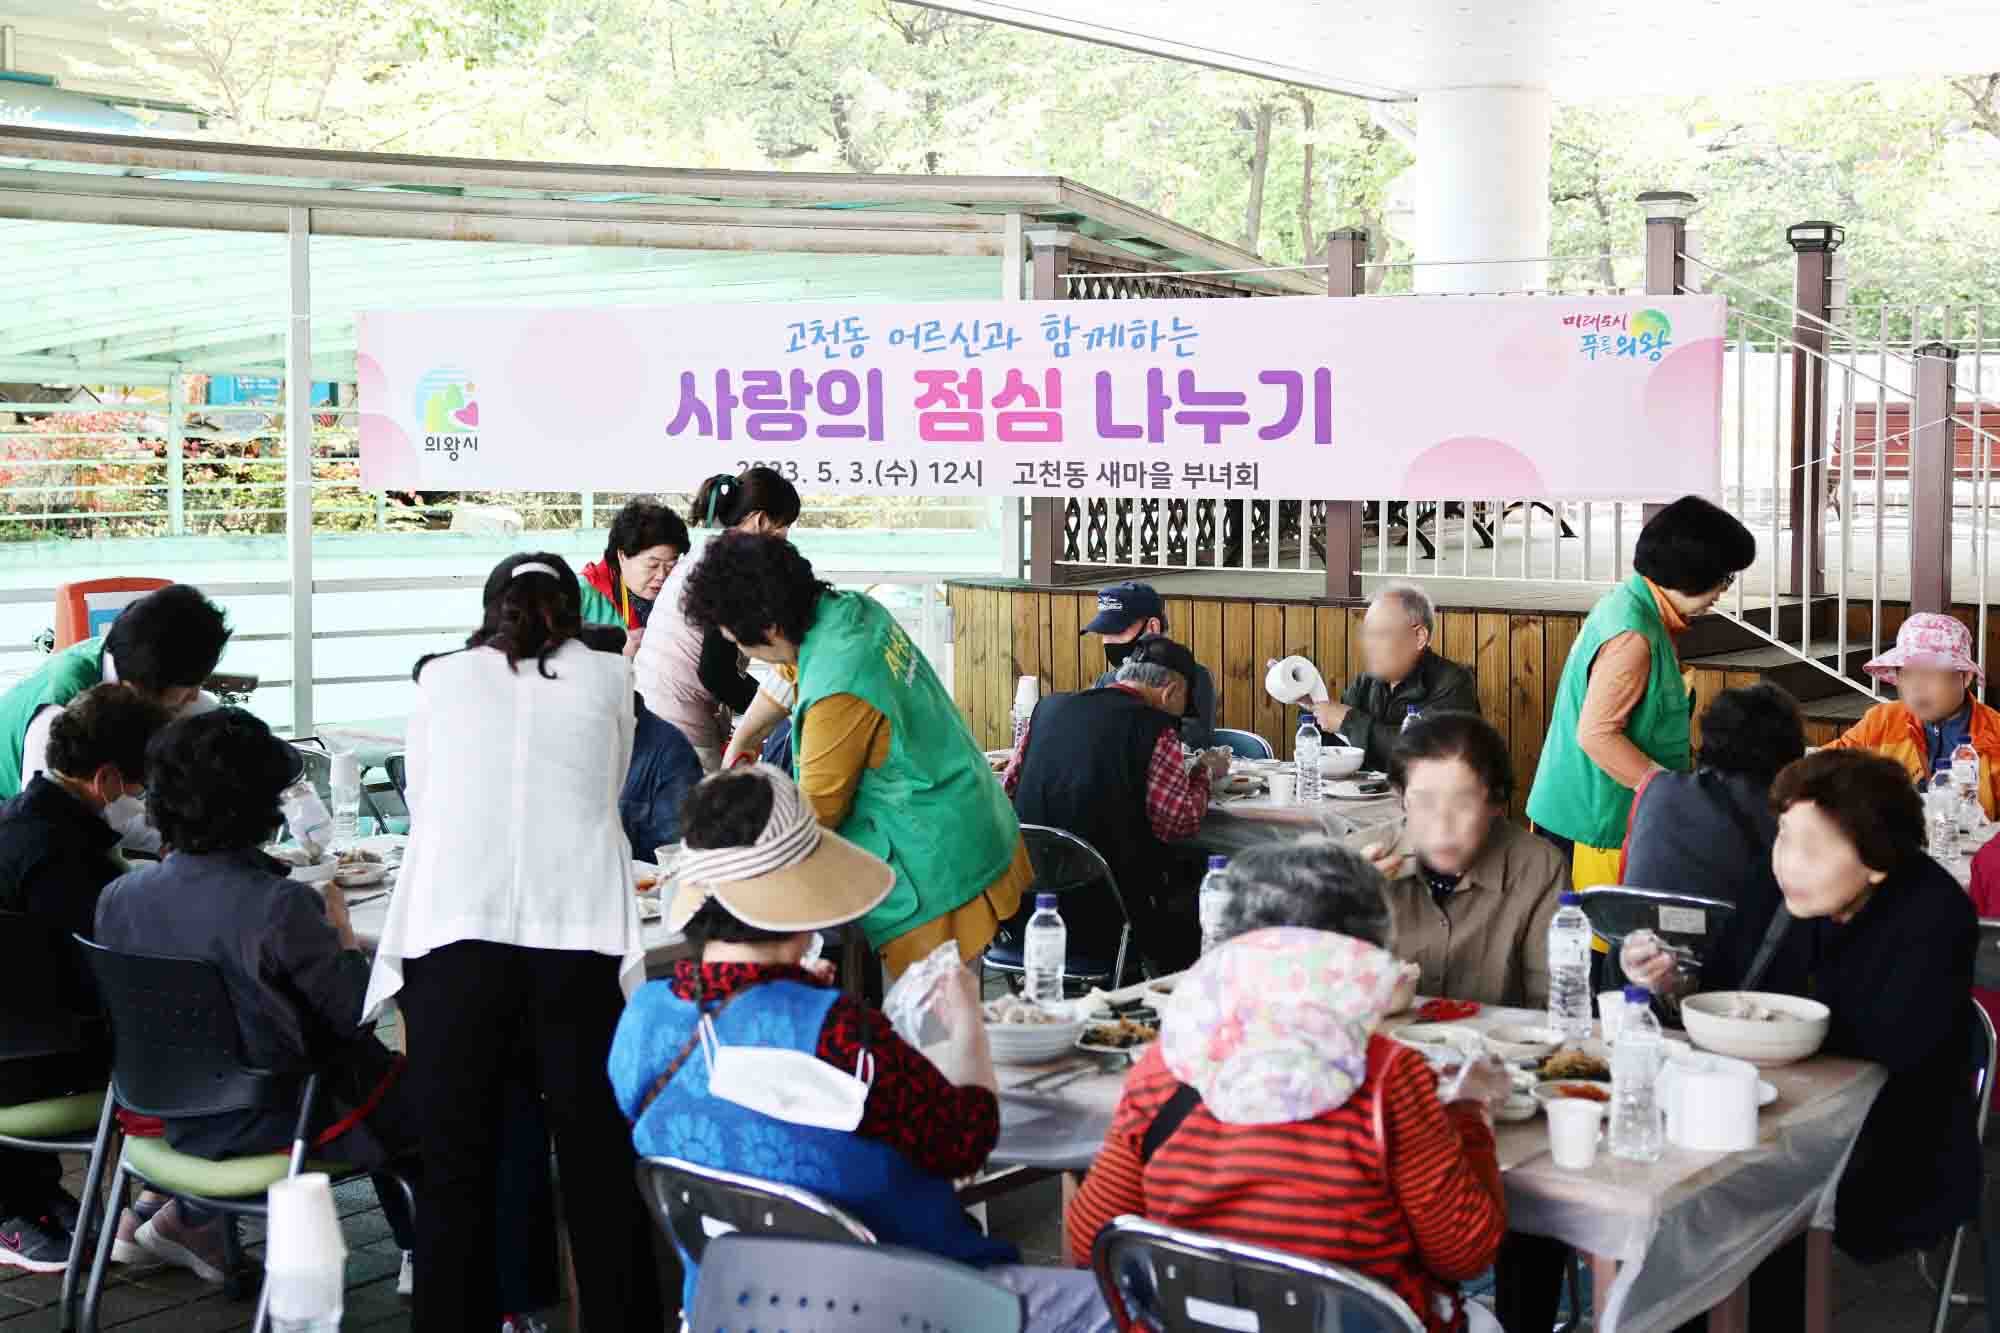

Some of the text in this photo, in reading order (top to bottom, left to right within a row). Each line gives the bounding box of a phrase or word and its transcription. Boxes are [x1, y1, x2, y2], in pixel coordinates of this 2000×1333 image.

[785, 313, 1200, 359] 고천동 어르신과 함께하는
[1562, 313, 1627, 332] 미래도시
[665, 367, 1333, 445] 사랑의 점심 나누기
[424, 436, 478, 462] 의왕시
[817, 461, 840, 485] 5.
[849, 458, 918, 487] 3.(수)
[928, 459, 983, 488] 12시
[1012, 459, 1089, 489] 고천동
[1095, 460, 1174, 490] 새마을
[1181, 461, 1260, 491] 부녀회
